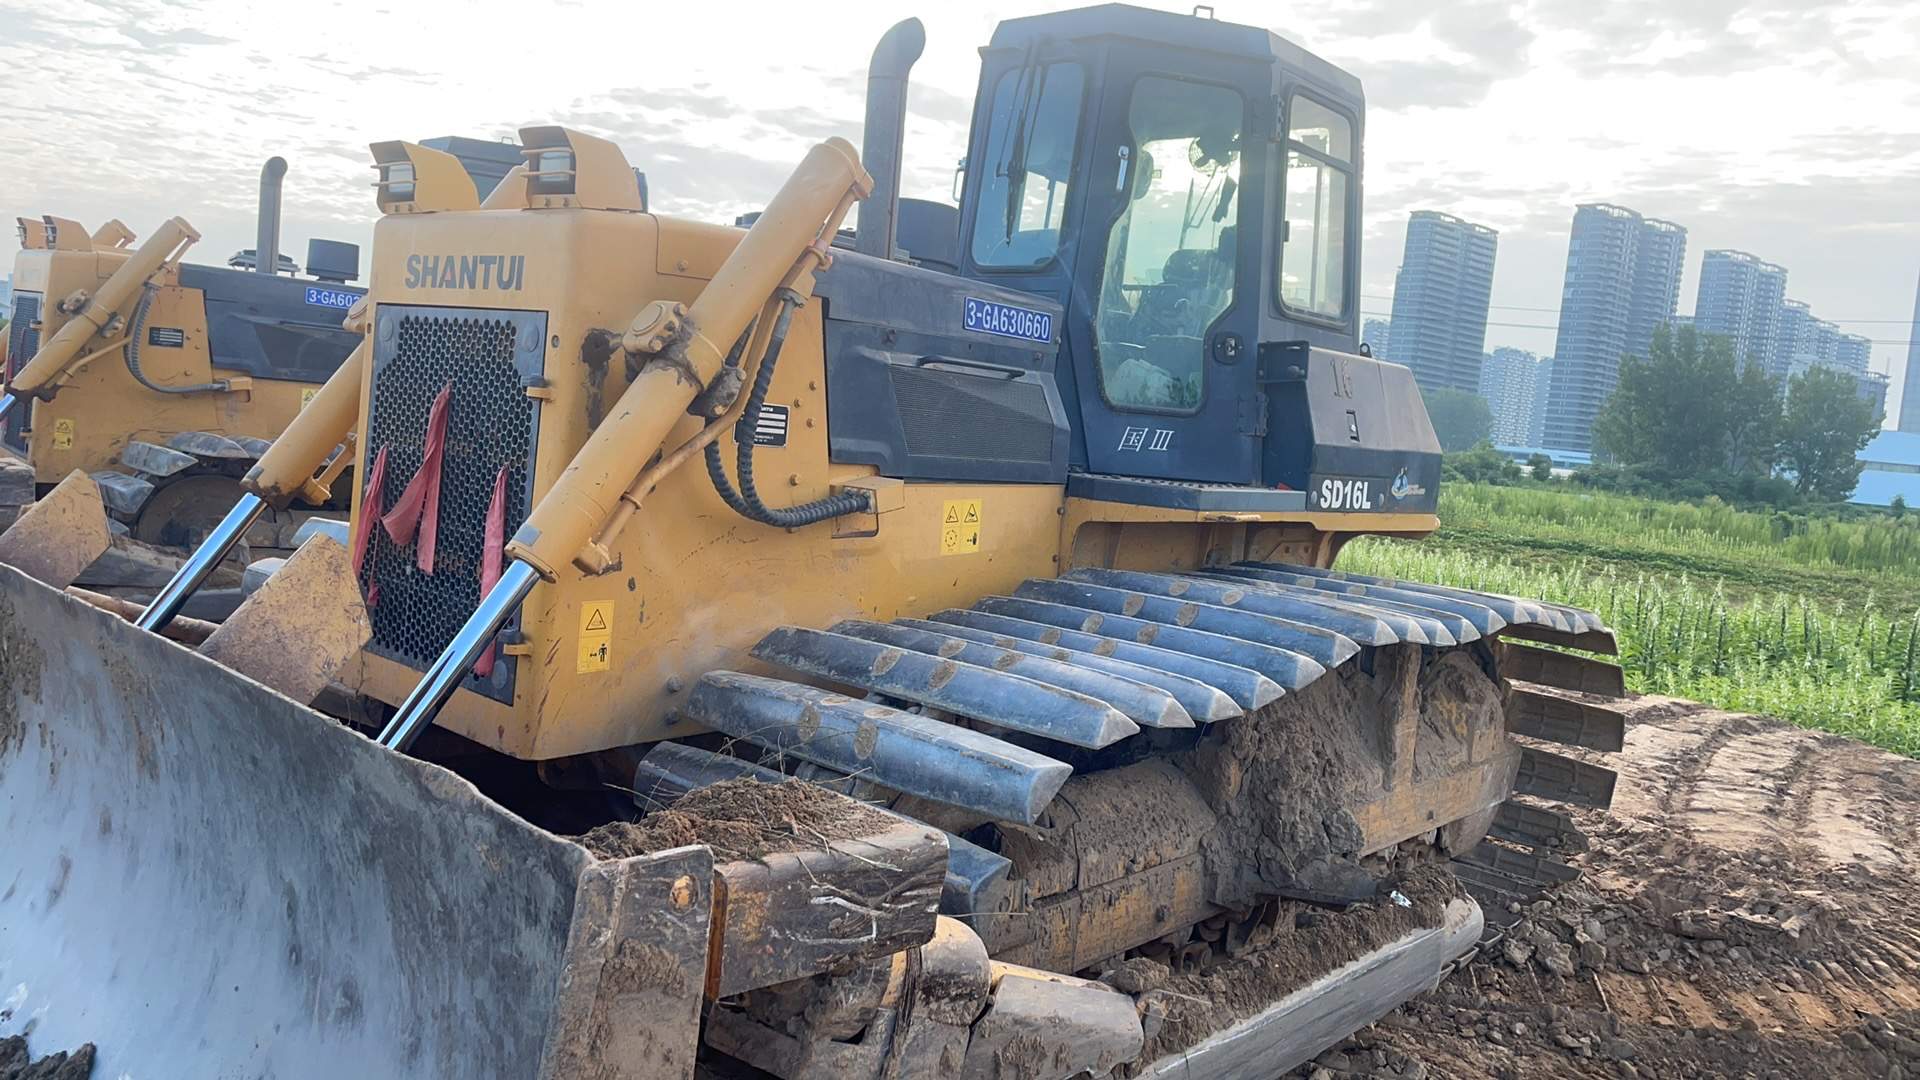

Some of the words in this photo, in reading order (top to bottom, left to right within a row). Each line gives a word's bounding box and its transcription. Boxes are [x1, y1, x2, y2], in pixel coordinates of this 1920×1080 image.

[405, 254, 525, 291] SHANTUI
[967, 301, 1049, 339] 3-GA630660
[1320, 479, 1371, 509] SD16L
